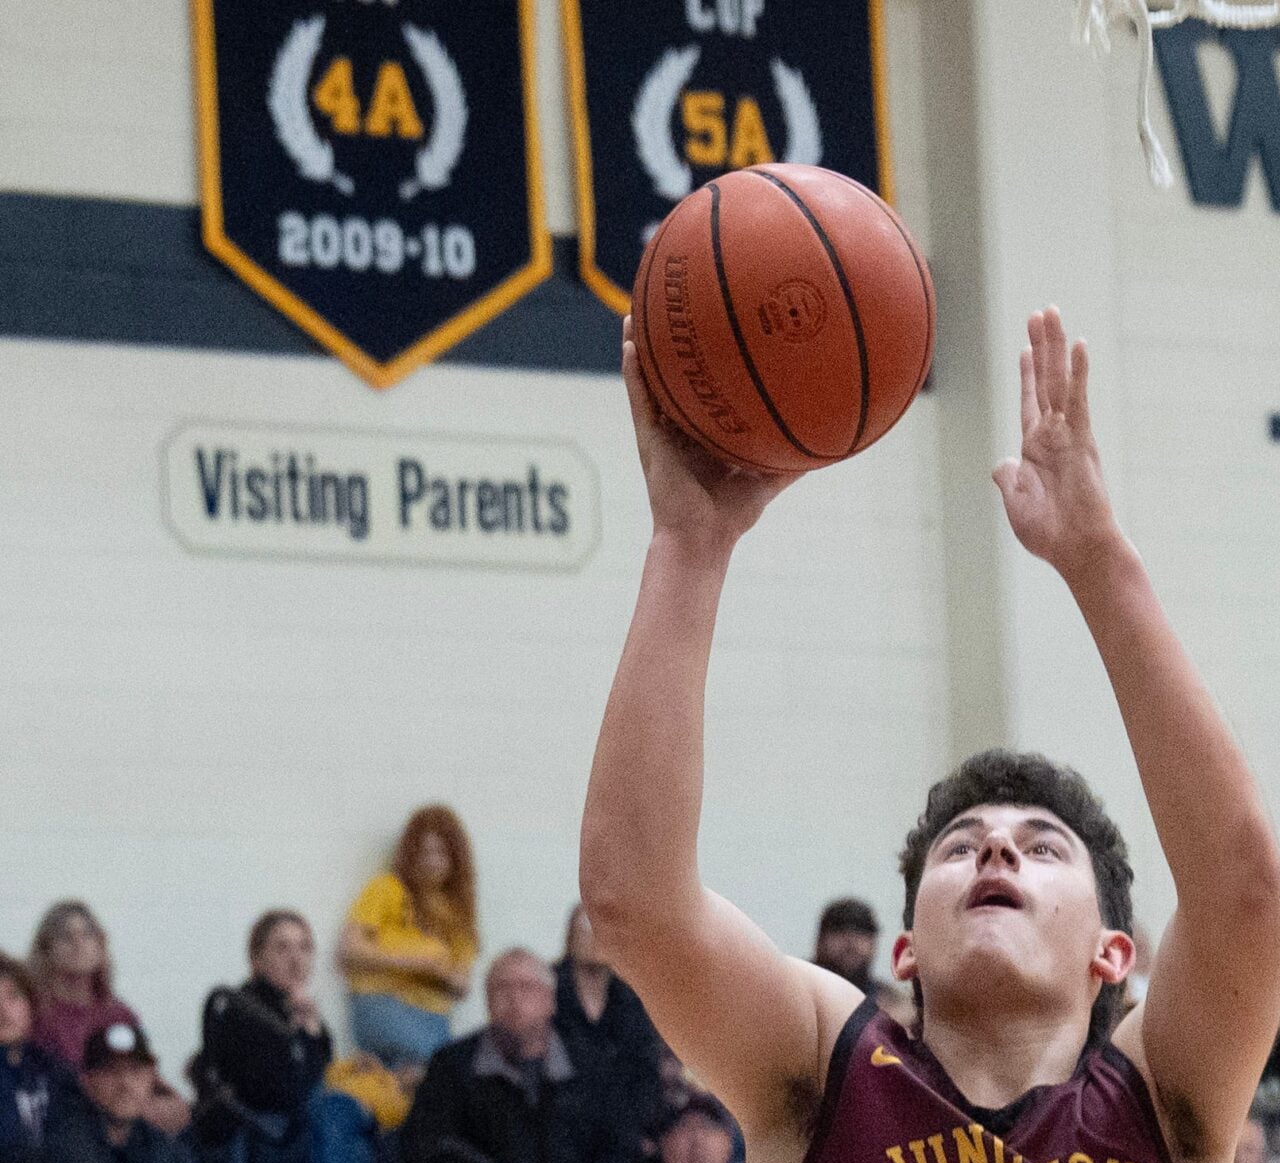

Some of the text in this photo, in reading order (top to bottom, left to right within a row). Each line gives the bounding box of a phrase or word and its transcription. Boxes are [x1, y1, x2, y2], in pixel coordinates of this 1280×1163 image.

[312, 56, 424, 140] 4A
[680, 90, 776, 170] 5A
[278, 211, 477, 279] 2009-10
[195, 447, 571, 541] Visiting Parents
